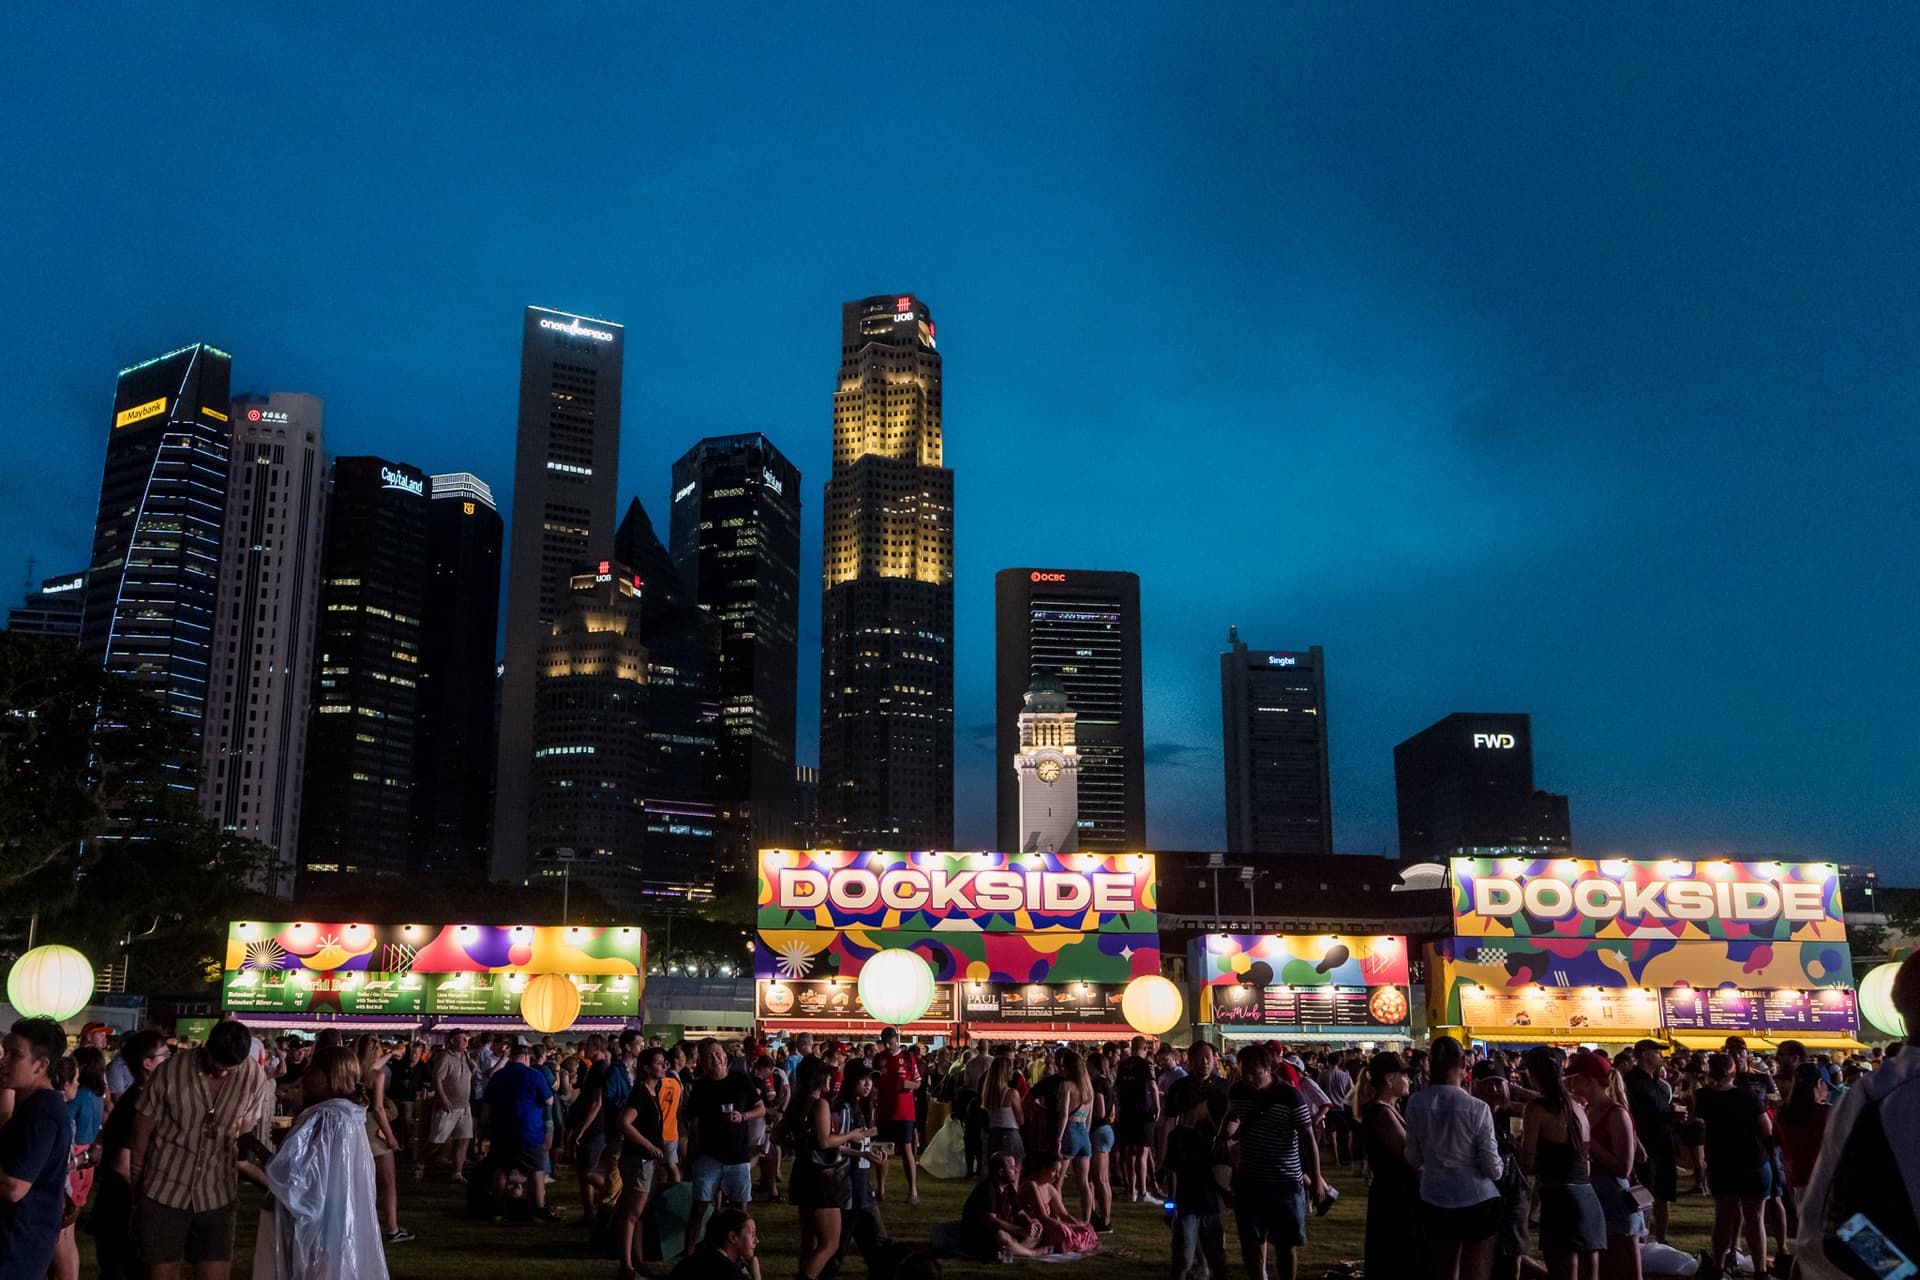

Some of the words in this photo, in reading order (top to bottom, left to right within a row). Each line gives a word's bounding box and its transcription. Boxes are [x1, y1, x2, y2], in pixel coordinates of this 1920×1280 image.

[894, 312, 914, 323] UOB
[127, 402, 161, 421] Maybank
[381, 466, 423, 493] CapitaLand
[596, 574, 612, 583] UOB
[1040, 573, 1066, 582] OCBC
[1268, 655, 1295, 667] Singtel
[1473, 733, 1515, 749] FWD
[778, 867, 1137, 912] DOCKSIDE
[1474, 877, 1827, 921] DOCKSIDE
[967, 994, 1000, 1004] PAUL
